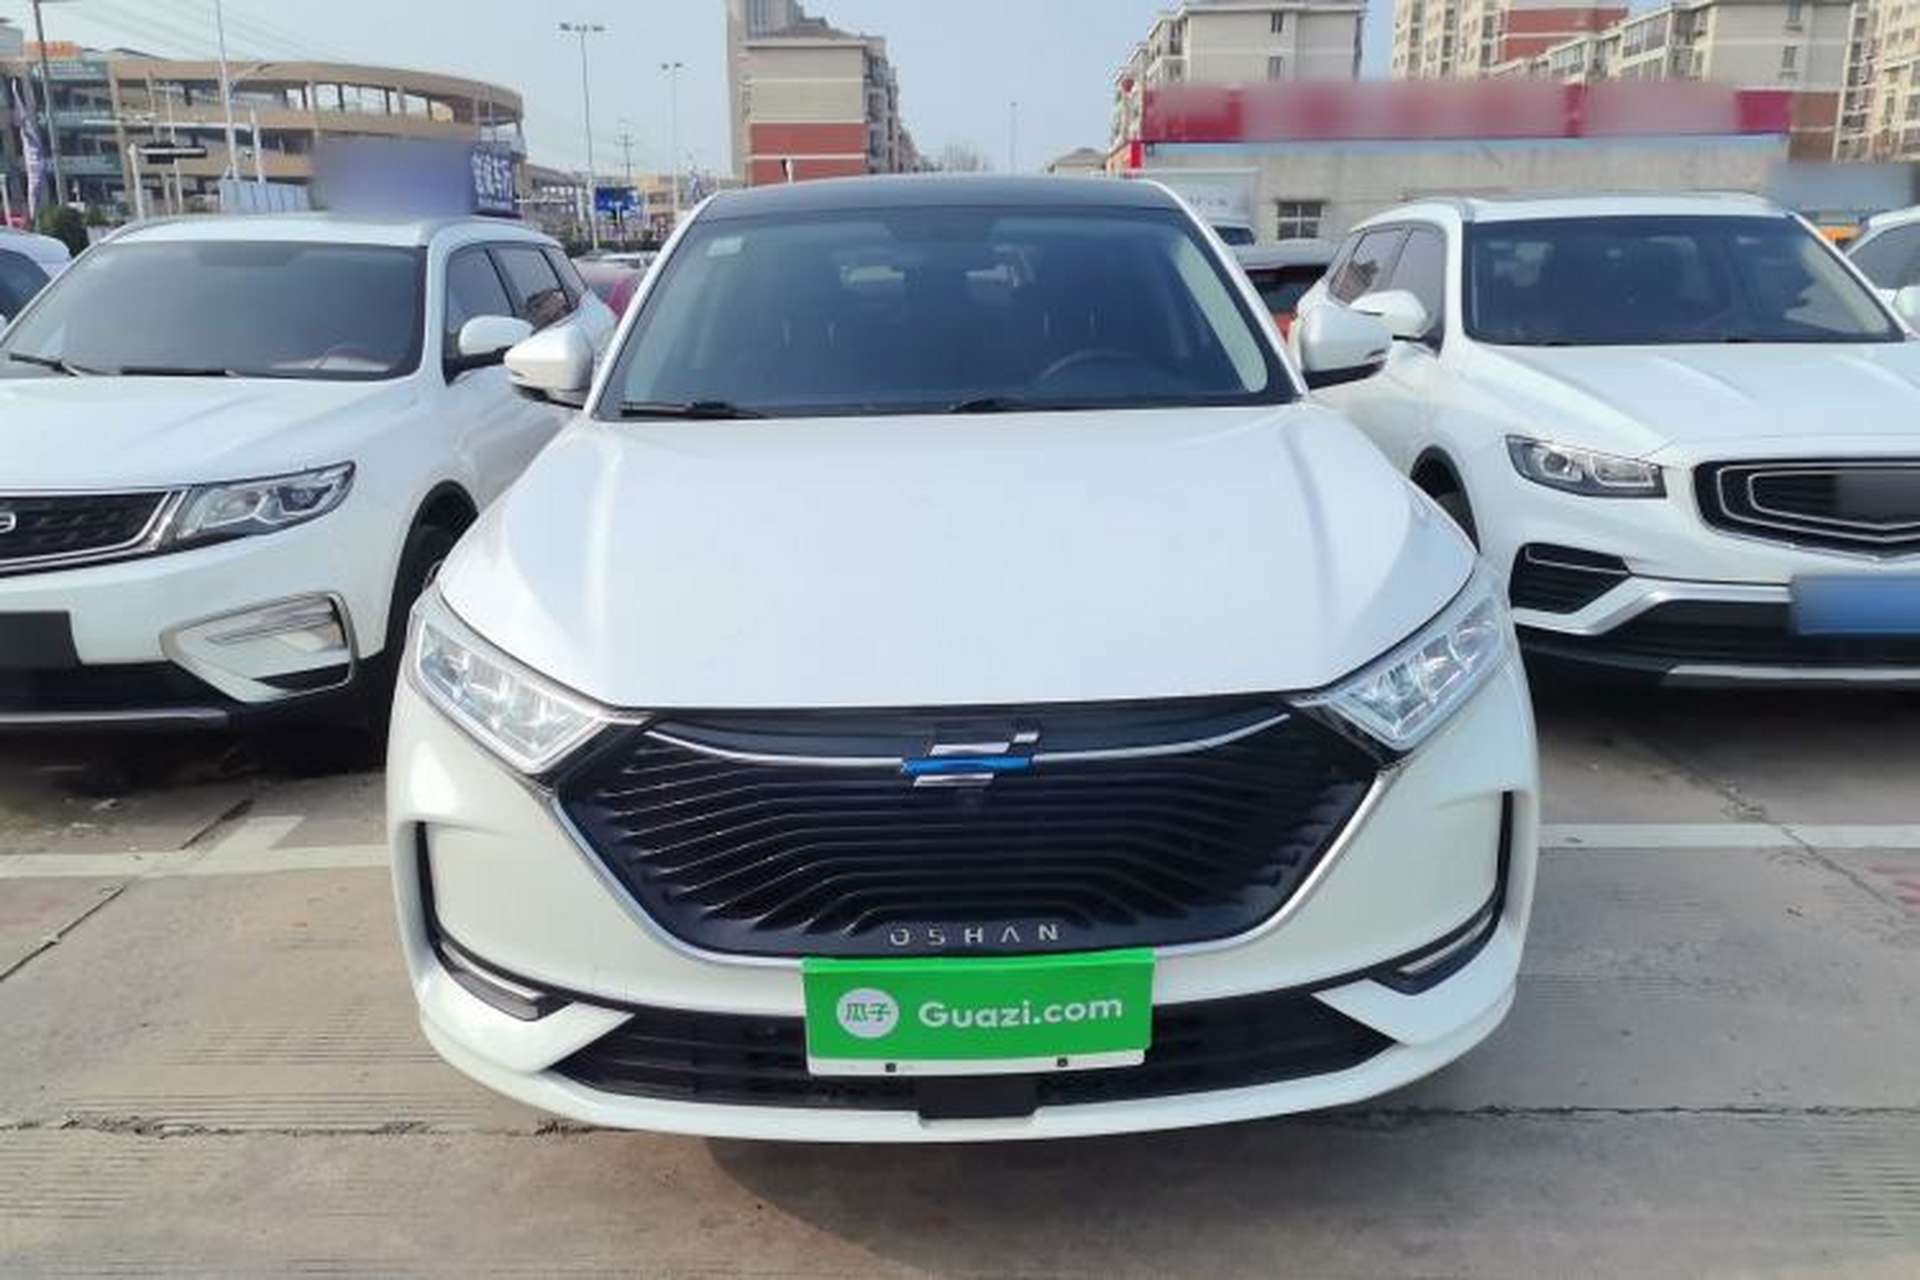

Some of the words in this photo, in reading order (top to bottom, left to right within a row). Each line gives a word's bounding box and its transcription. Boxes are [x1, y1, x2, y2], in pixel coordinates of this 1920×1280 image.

[889, 924, 1059, 946] OSHAN
[845, 1002, 892, 1023] 瓜子
[918, 998, 1123, 1028] Guazi.com
